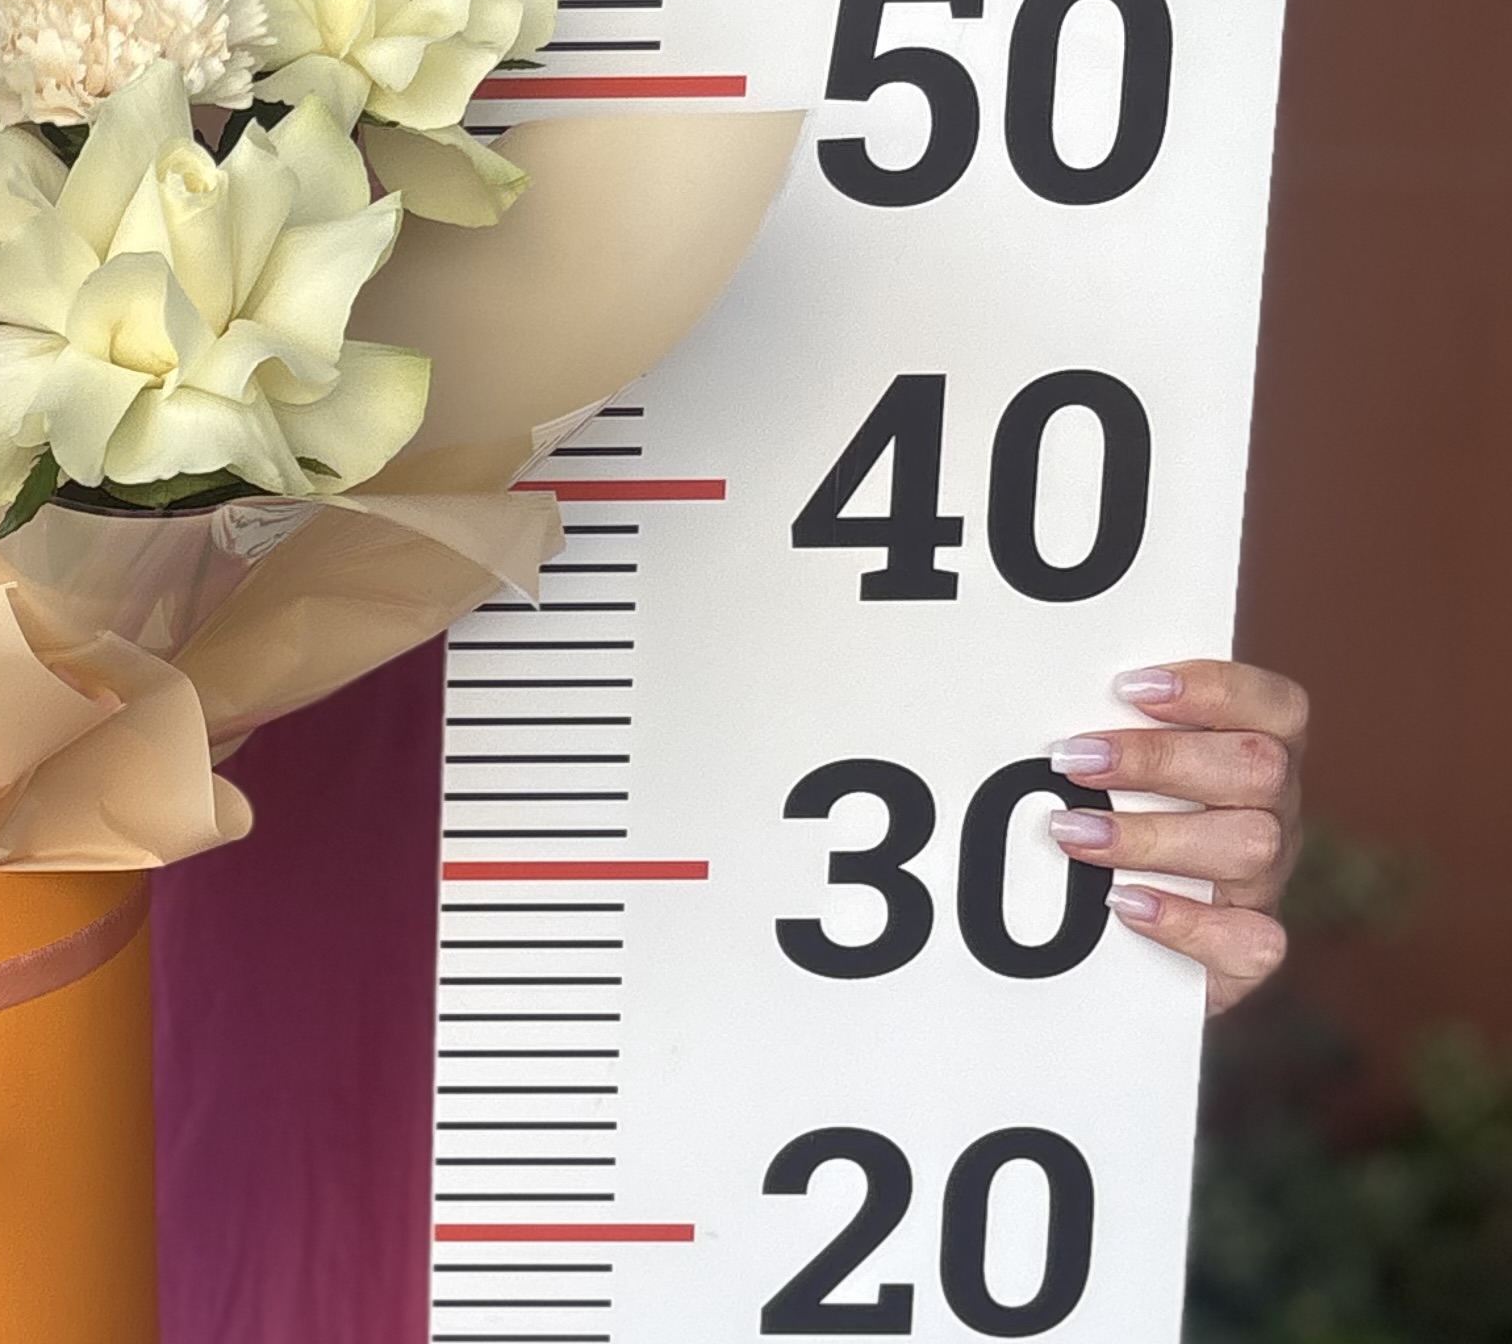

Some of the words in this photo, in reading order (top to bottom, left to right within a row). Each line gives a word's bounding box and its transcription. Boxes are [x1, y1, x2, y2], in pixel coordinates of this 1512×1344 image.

[792, 370, 1150, 602] 40
[776, 758, 1115, 979] 30
[762, 1128, 1094, 1337] 20
